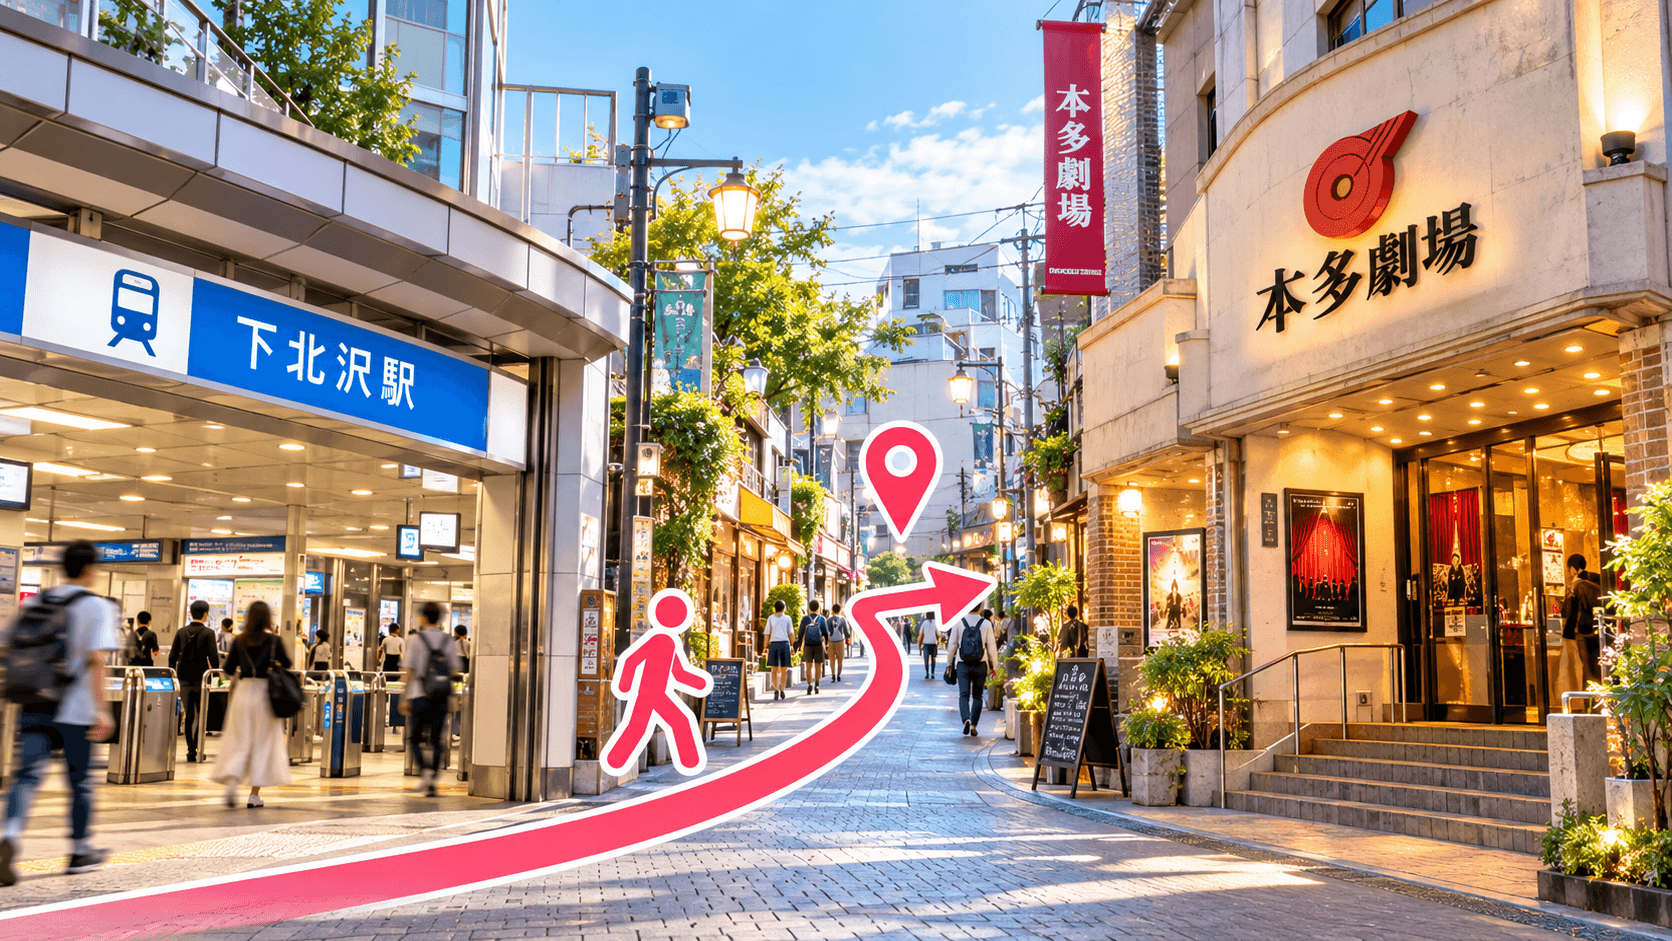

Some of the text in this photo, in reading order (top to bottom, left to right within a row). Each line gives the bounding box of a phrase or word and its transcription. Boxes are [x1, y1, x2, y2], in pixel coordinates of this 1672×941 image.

[1056, 83, 1092, 228] 本多劇場
[1256, 202, 1479, 333] 本多劇場
[237, 315, 415, 410] 下北沢駅
